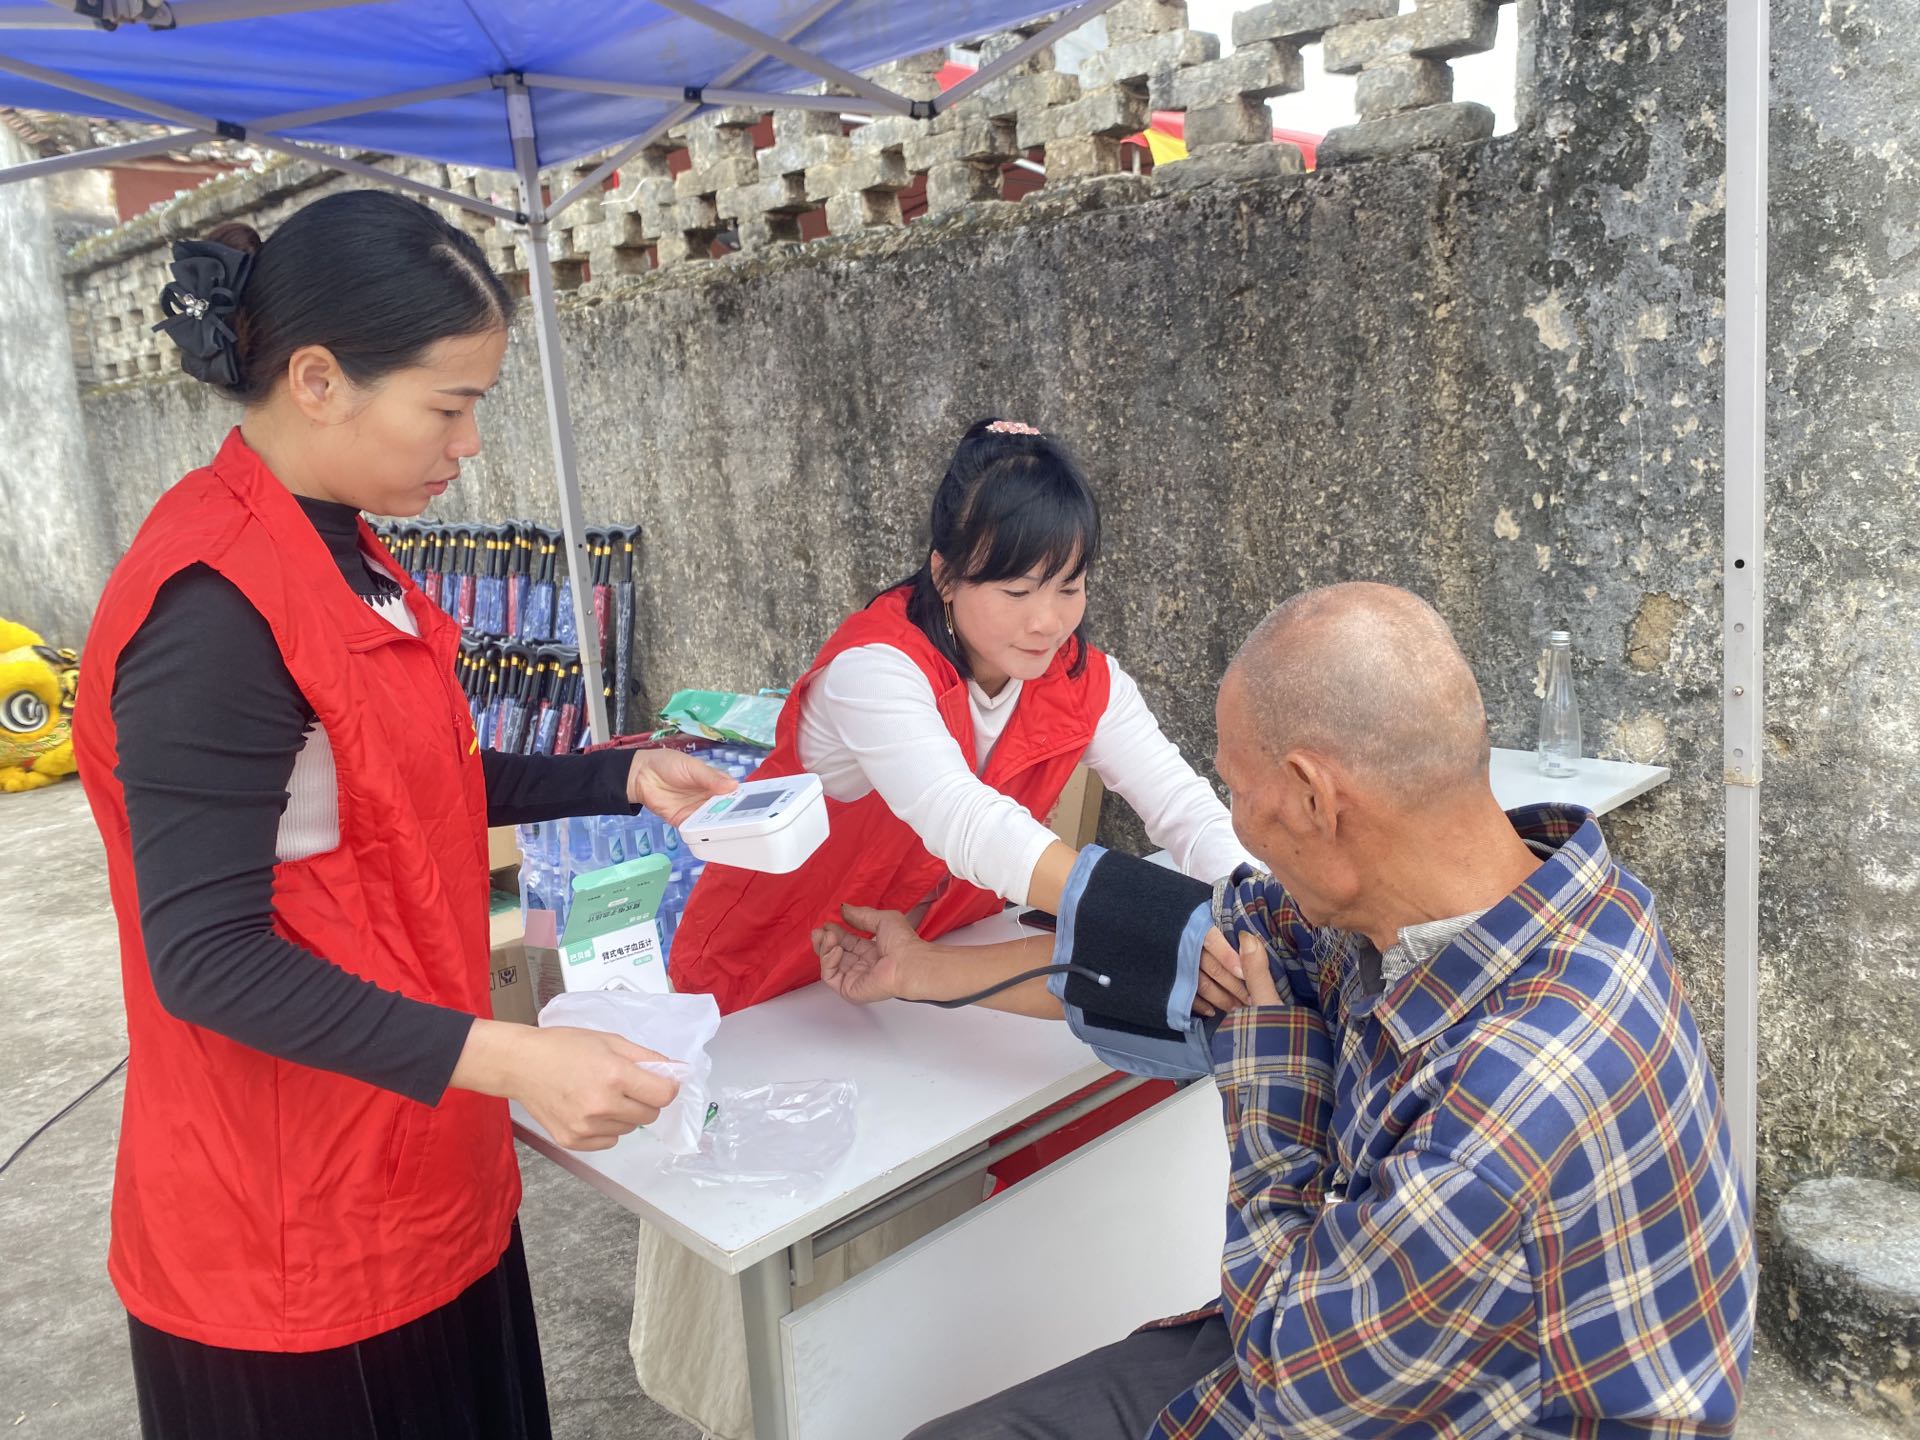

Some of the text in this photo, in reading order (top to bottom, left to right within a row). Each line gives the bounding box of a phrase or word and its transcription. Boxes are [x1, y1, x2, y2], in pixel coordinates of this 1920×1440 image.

[602, 938, 653, 961] 臂式电子血压计
